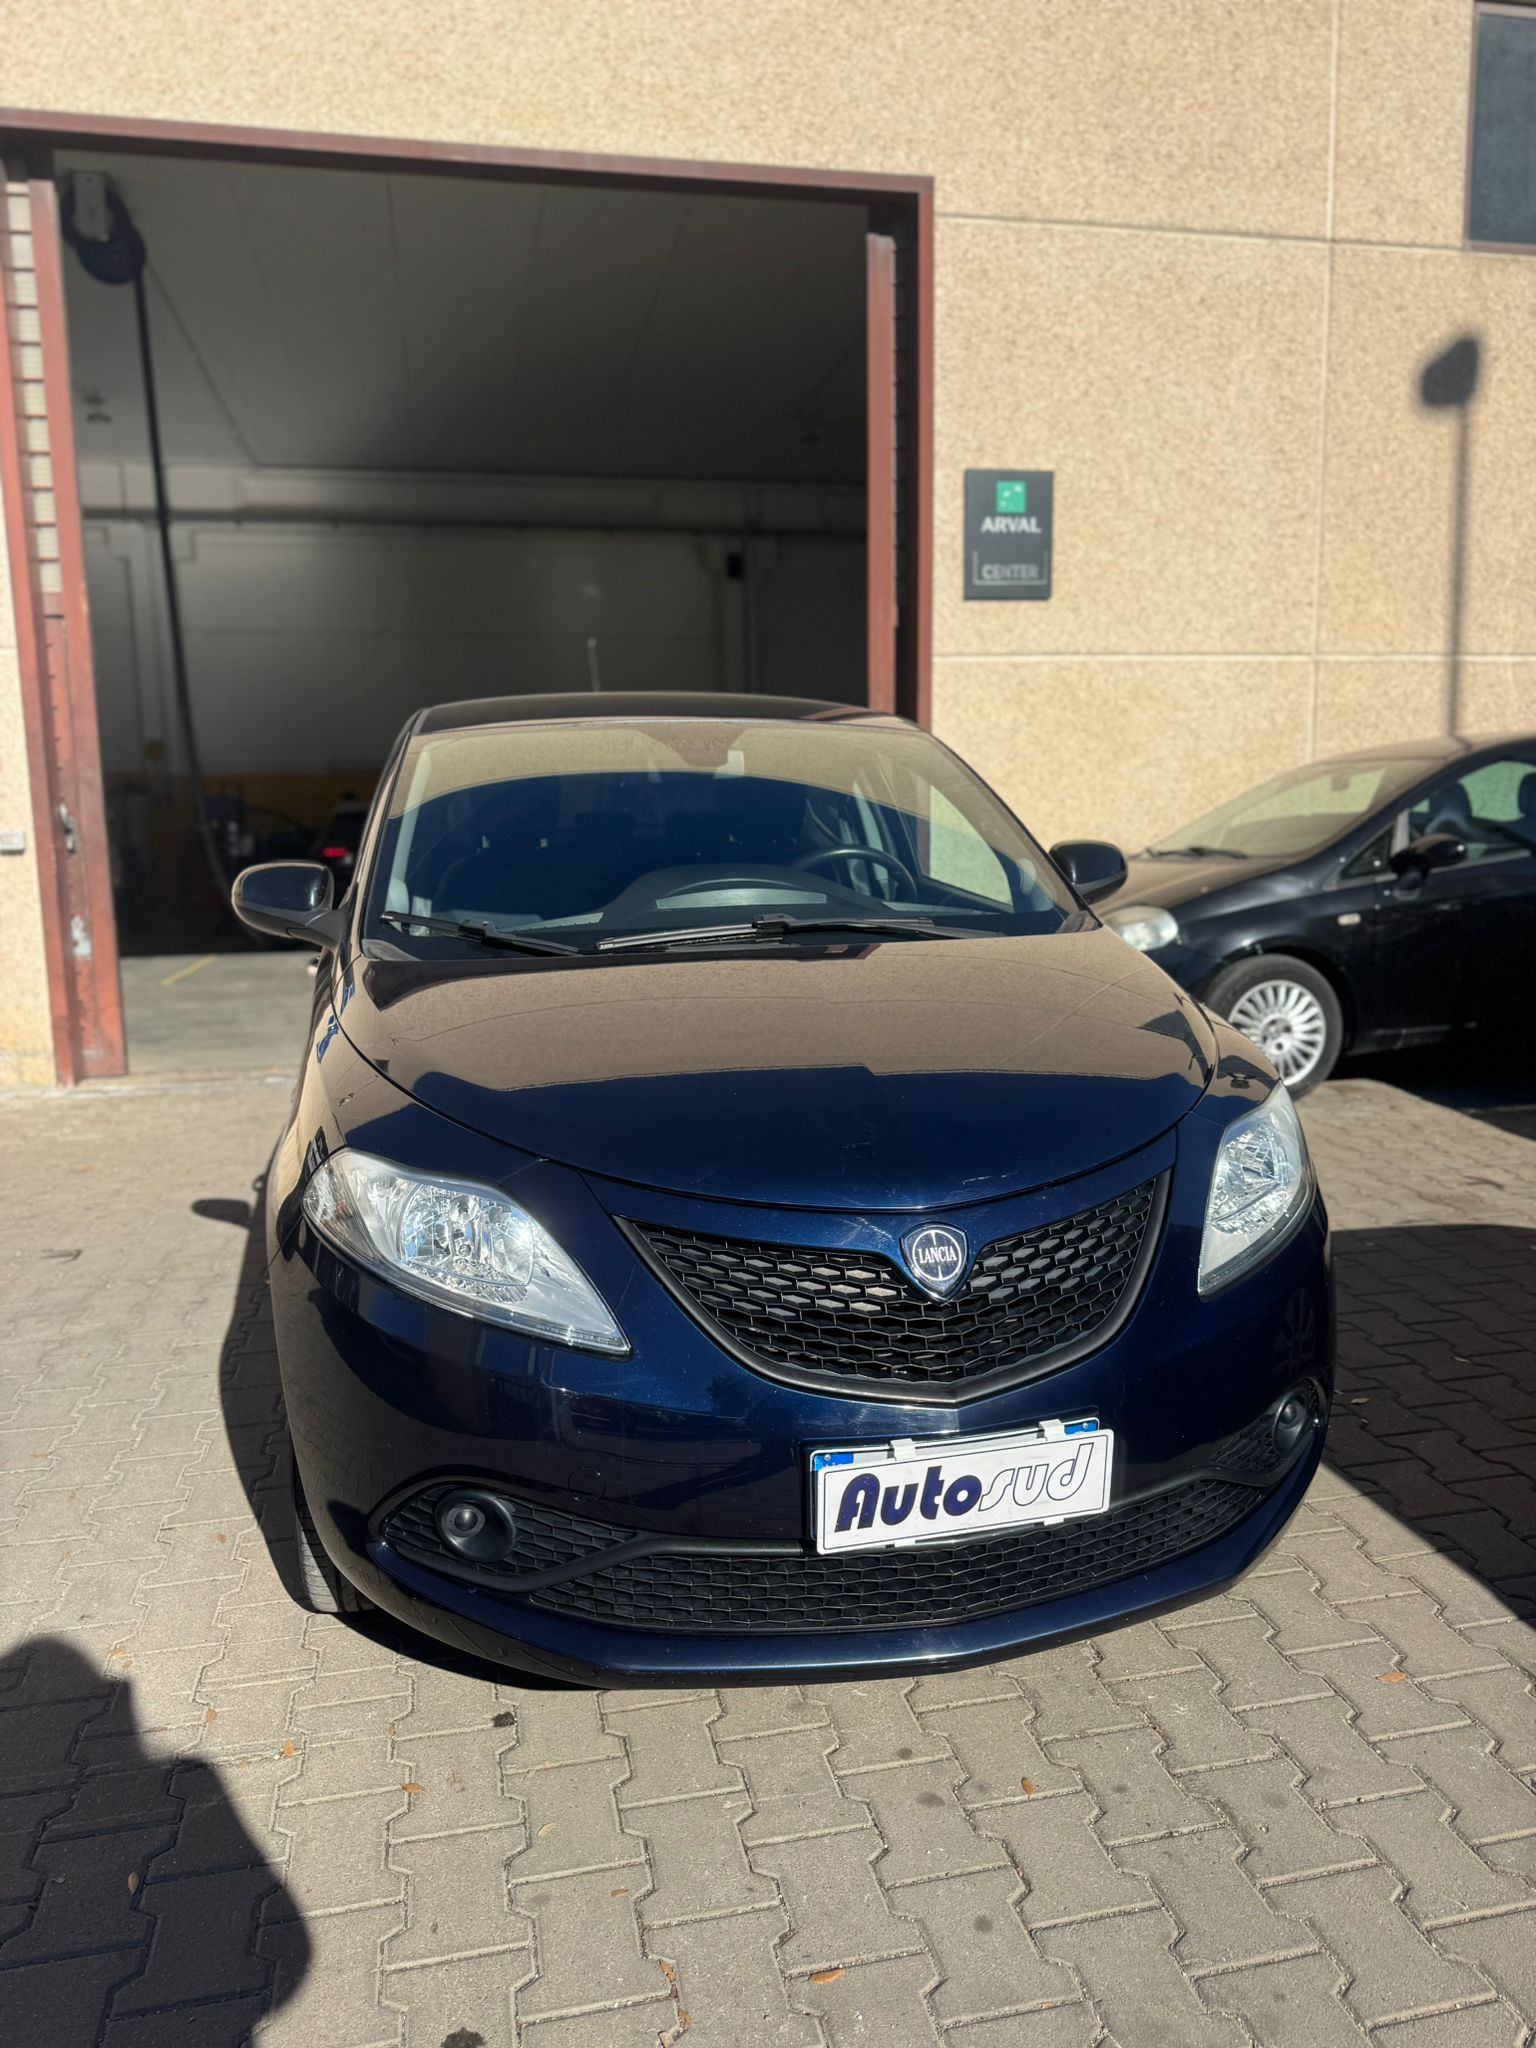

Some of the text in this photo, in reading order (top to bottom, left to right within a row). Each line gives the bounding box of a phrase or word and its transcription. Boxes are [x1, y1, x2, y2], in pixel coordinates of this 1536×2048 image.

[981, 516, 1042, 533] ARVAL
[981, 563, 1038, 579] CENTER
[918, 1246, 957, 1263] LANCIA
[834, 1442, 1095, 1532] Autosud
